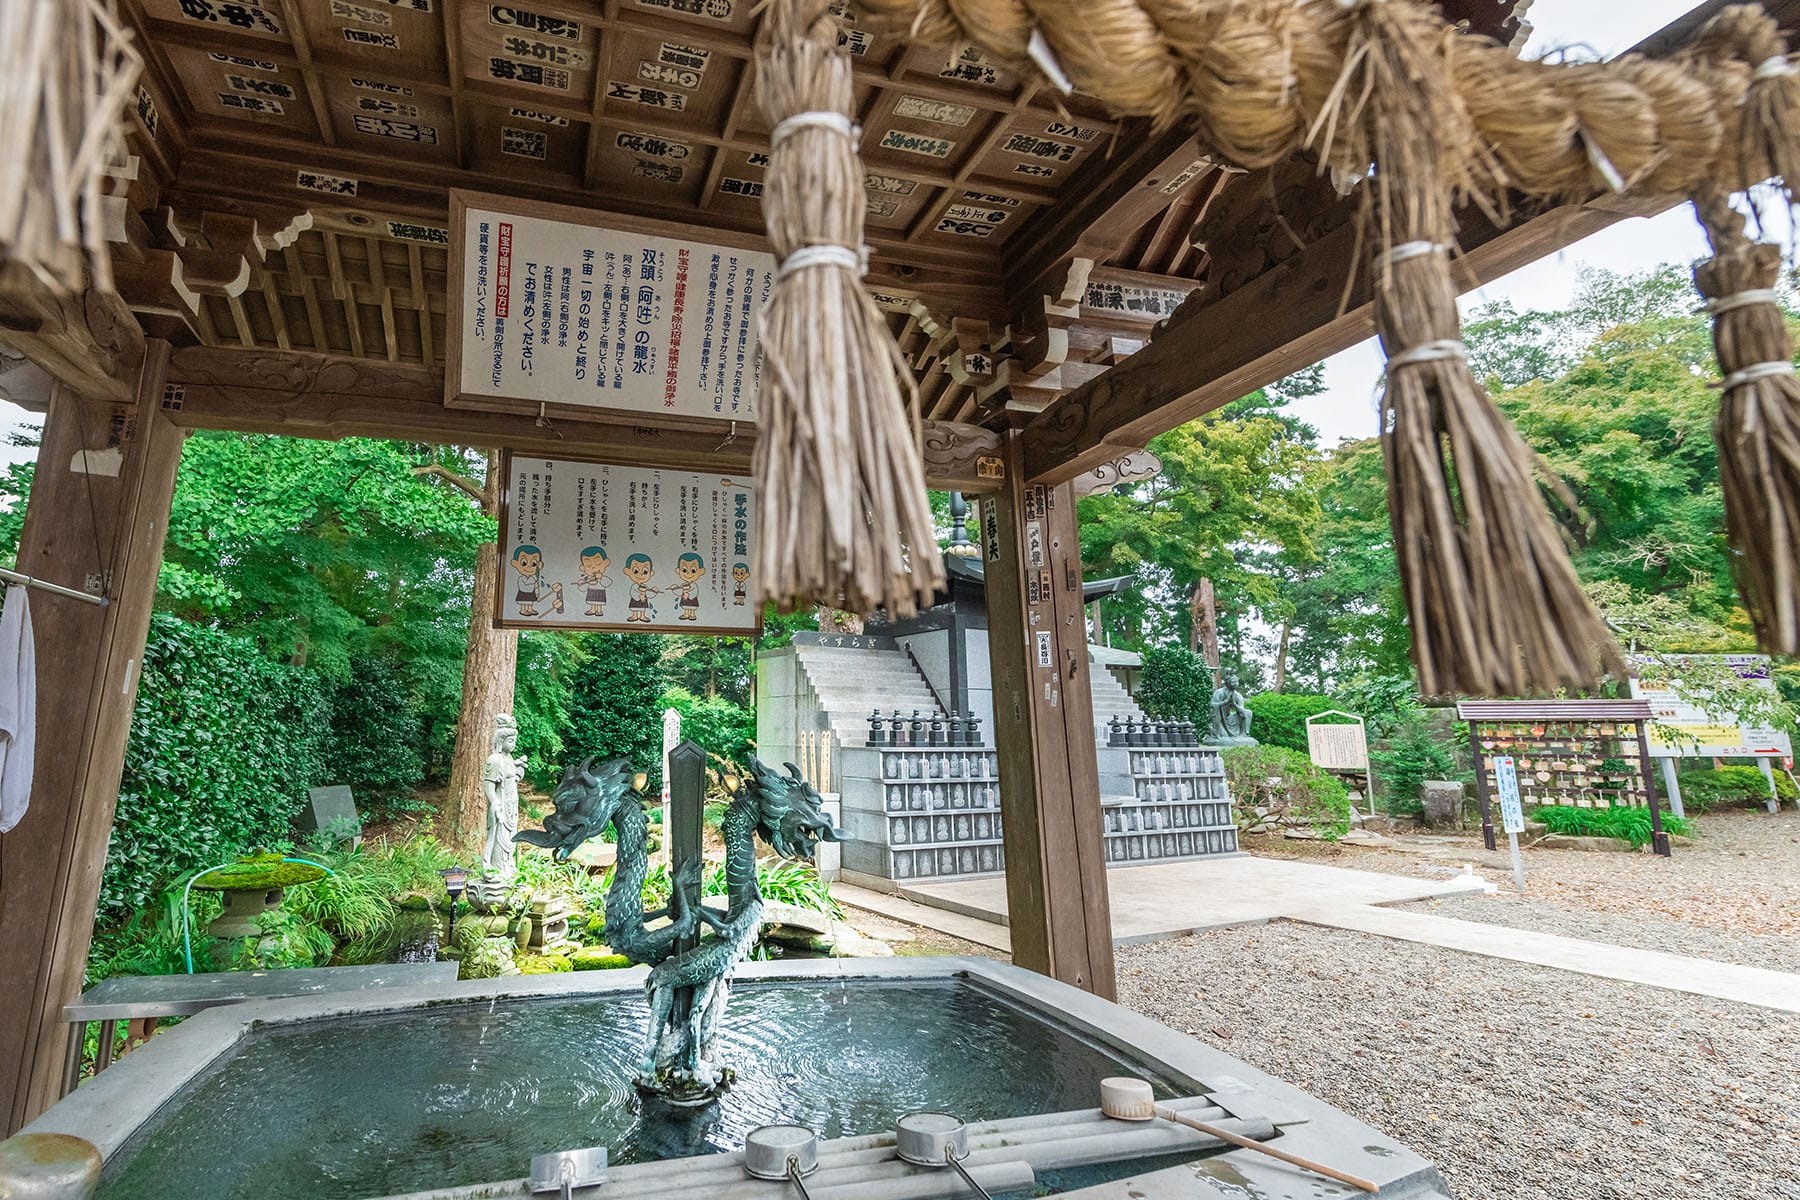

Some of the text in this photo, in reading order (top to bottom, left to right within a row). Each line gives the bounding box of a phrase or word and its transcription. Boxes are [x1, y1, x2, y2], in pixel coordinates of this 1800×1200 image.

[506, 37, 558, 61] 石井
[475, 222, 490, 342] 硬貨等をお洗いください。
[521, 262, 538, 378] でお清めください。
[575, 249, 595, 380] 宇宙一切の始めと終り
[972, 354, 986, 373] 林
[734, 493, 748, 556] 手水の作法
[818, 636, 878, 649] やすらぎ
